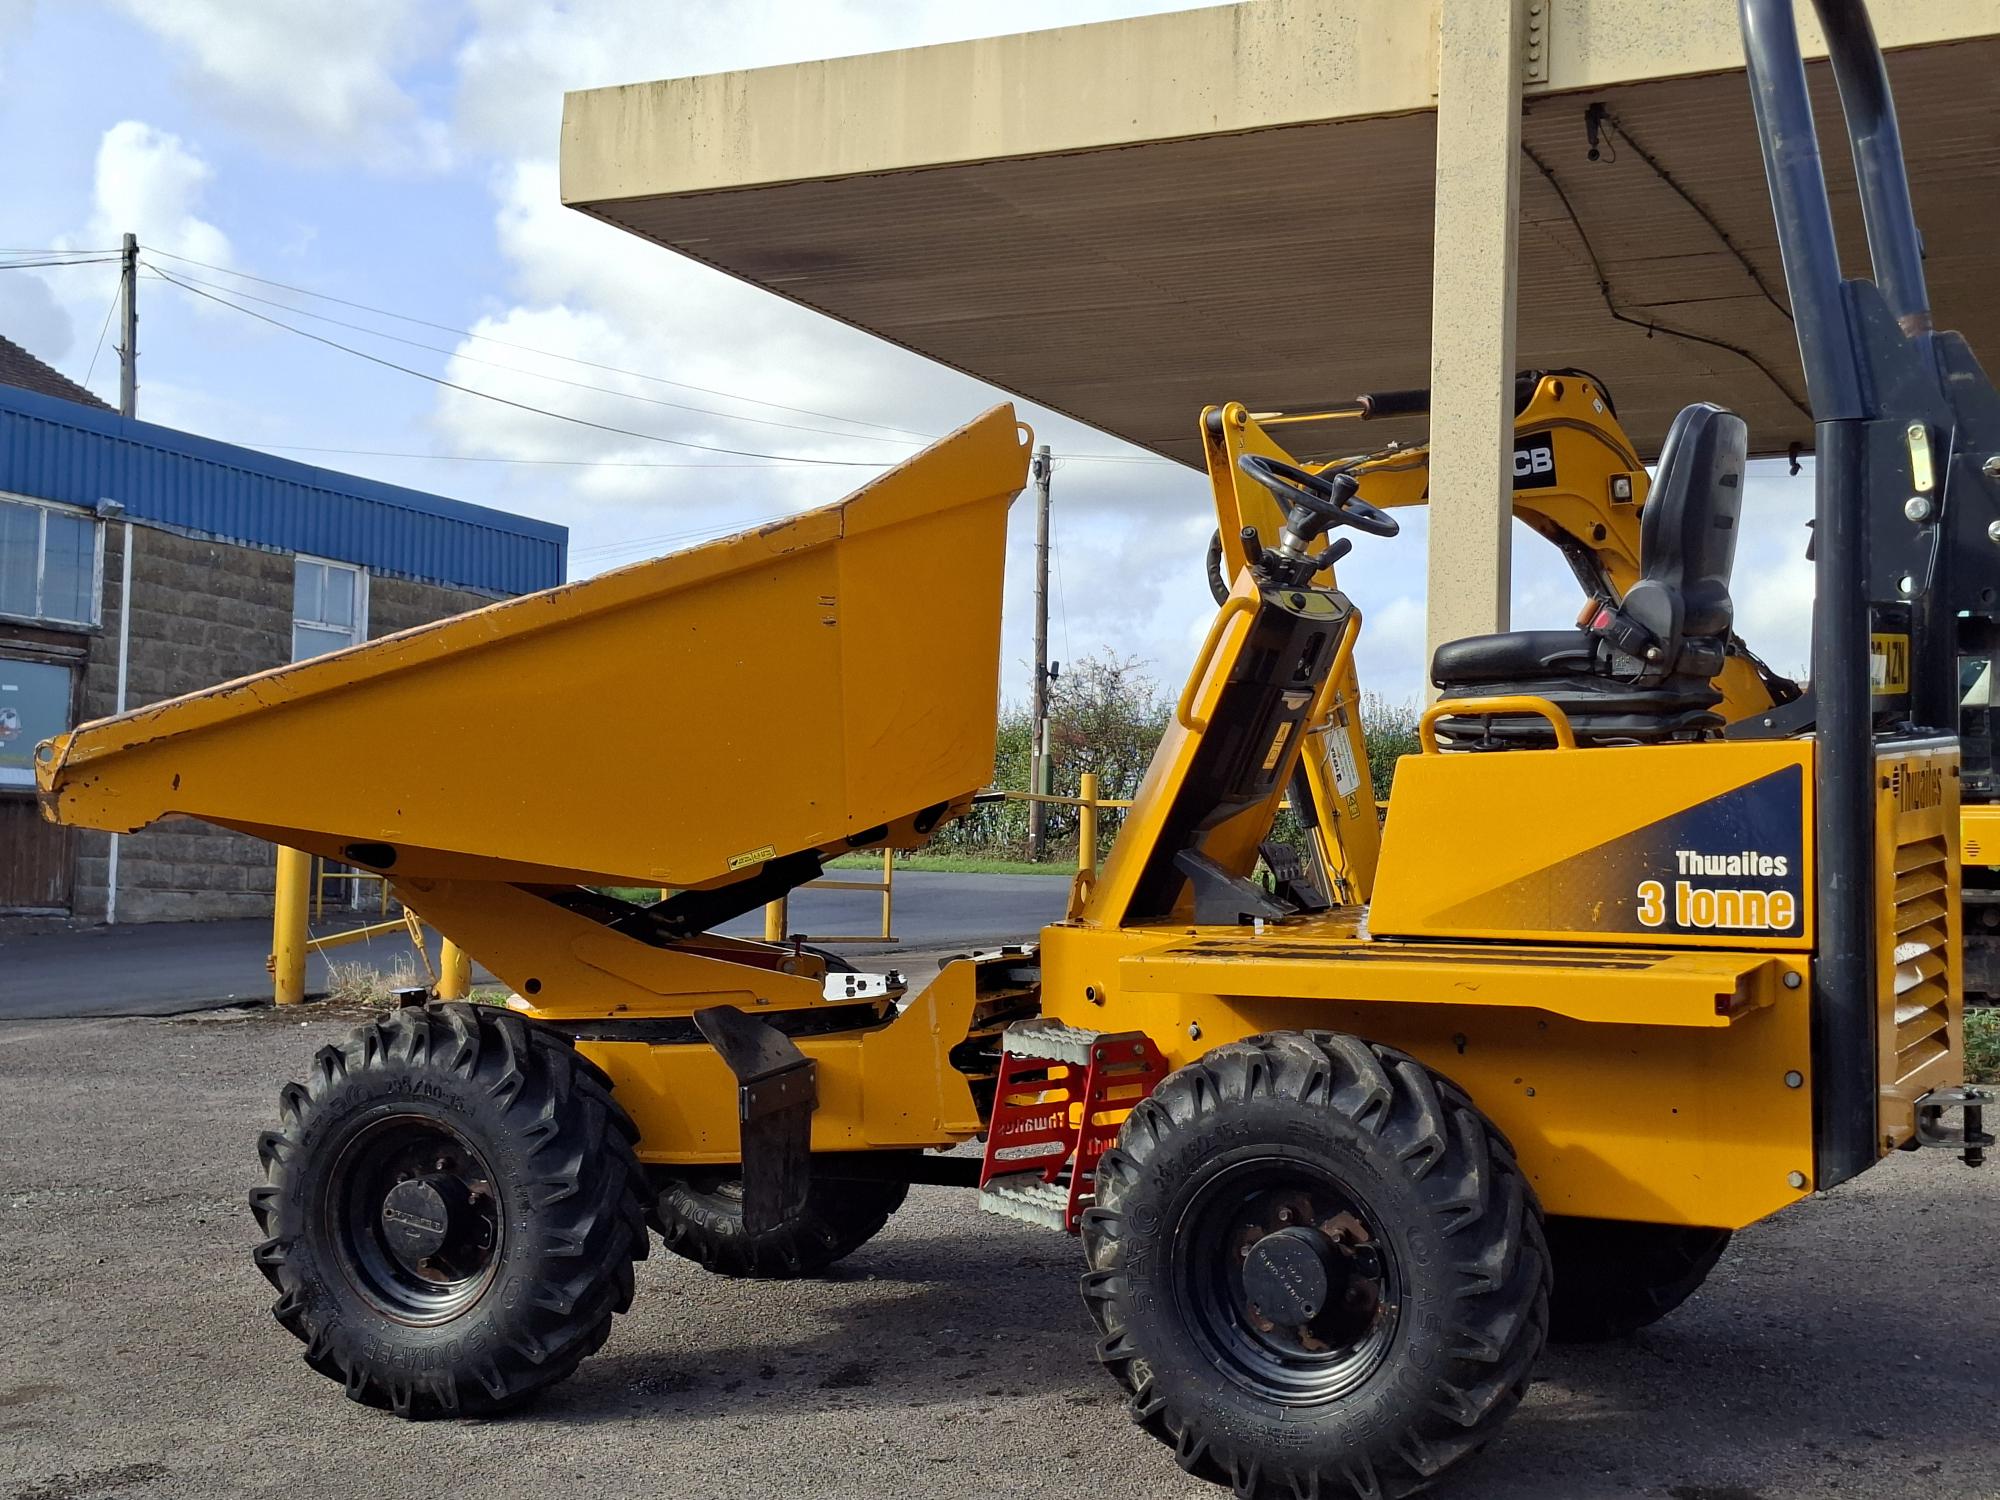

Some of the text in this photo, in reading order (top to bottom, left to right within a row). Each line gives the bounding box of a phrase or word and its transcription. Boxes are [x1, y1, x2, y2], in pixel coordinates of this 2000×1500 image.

[1513, 447, 1553, 477] CB
[1900, 760, 1943, 813] Thwaites
[1675, 850, 1788, 877] Thwaites
[1637, 880, 1795, 930] 3 tonne
[361, 1332, 465, 1371] DUMPER
